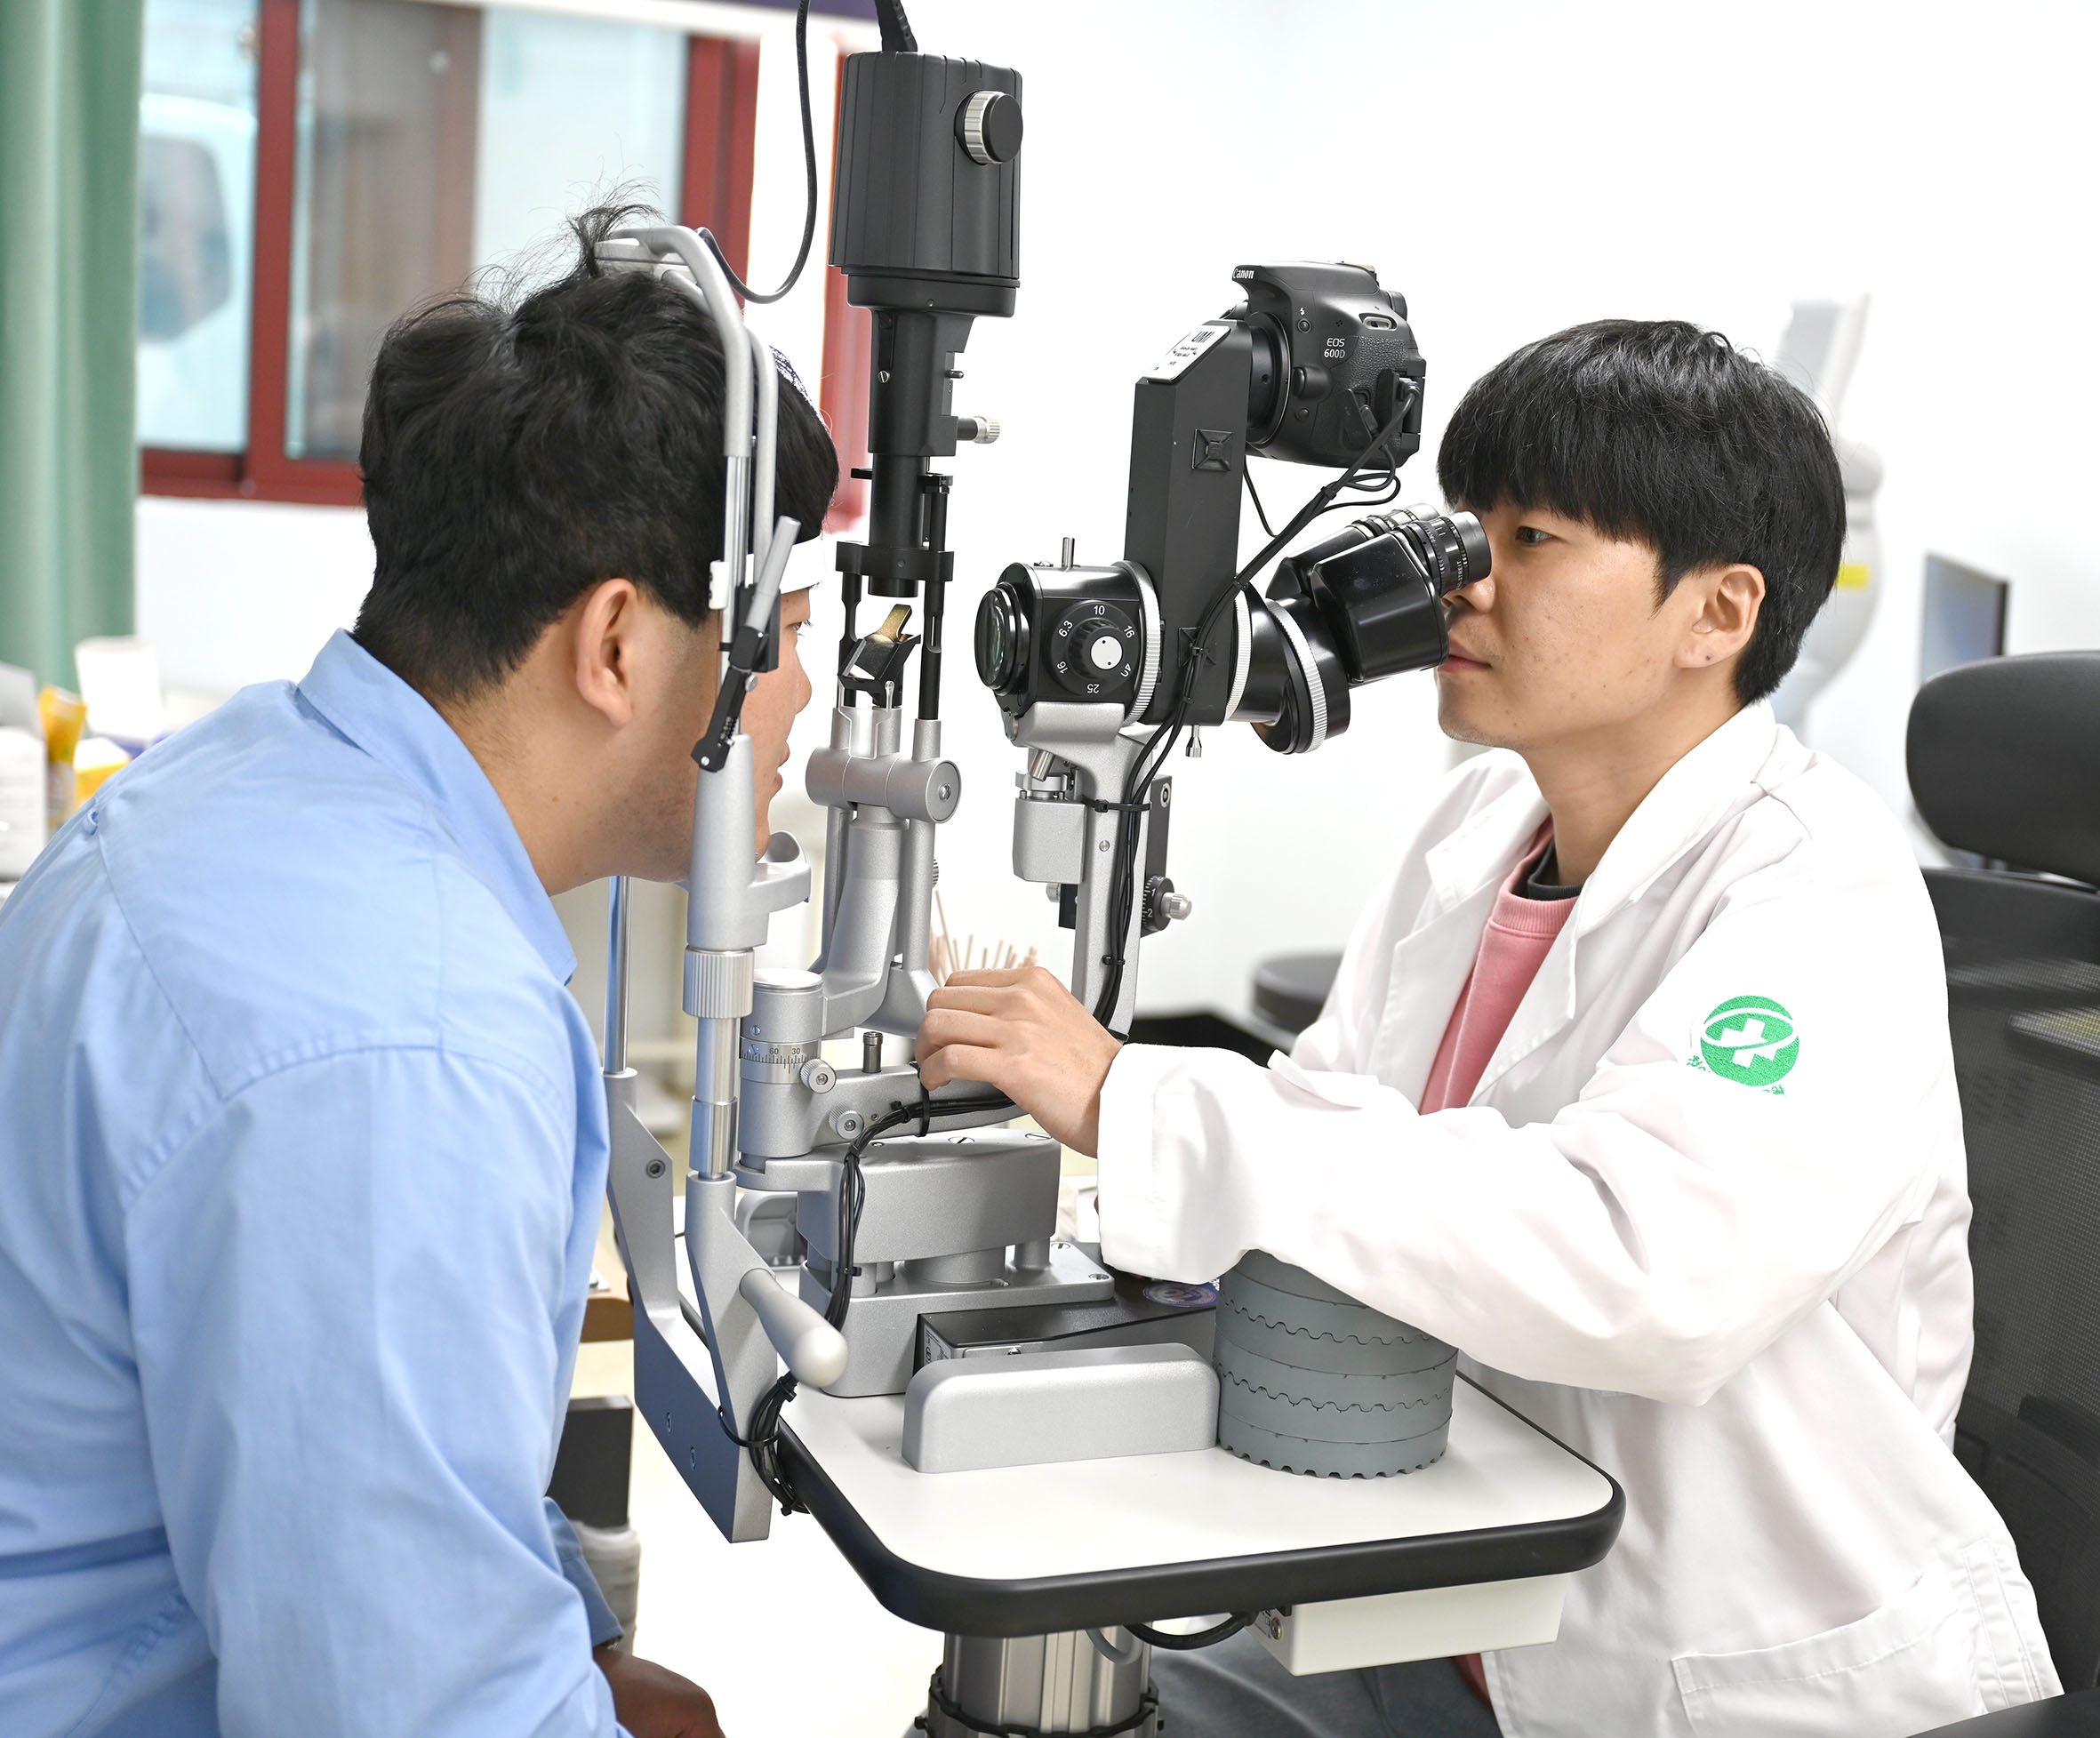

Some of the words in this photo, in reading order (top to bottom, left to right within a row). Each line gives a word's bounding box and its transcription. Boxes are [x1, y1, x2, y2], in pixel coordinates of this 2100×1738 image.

[1232, 268, 1254, 279] Canon
[1327, 338, 1345, 348] EOS
[1324, 348, 1346, 359] 600D
[1093, 605, 1105, 615] 10
[1058, 620, 1073, 637] 6.3
[1124, 625, 1135, 639] 16
[1056, 661, 1068, 675] 16
[1086, 683, 1100, 693] 25
[1147, 908, 1153, 917] 2
[769, 1047, 779, 1055] 60
[791, 1047, 801, 1055] 30
